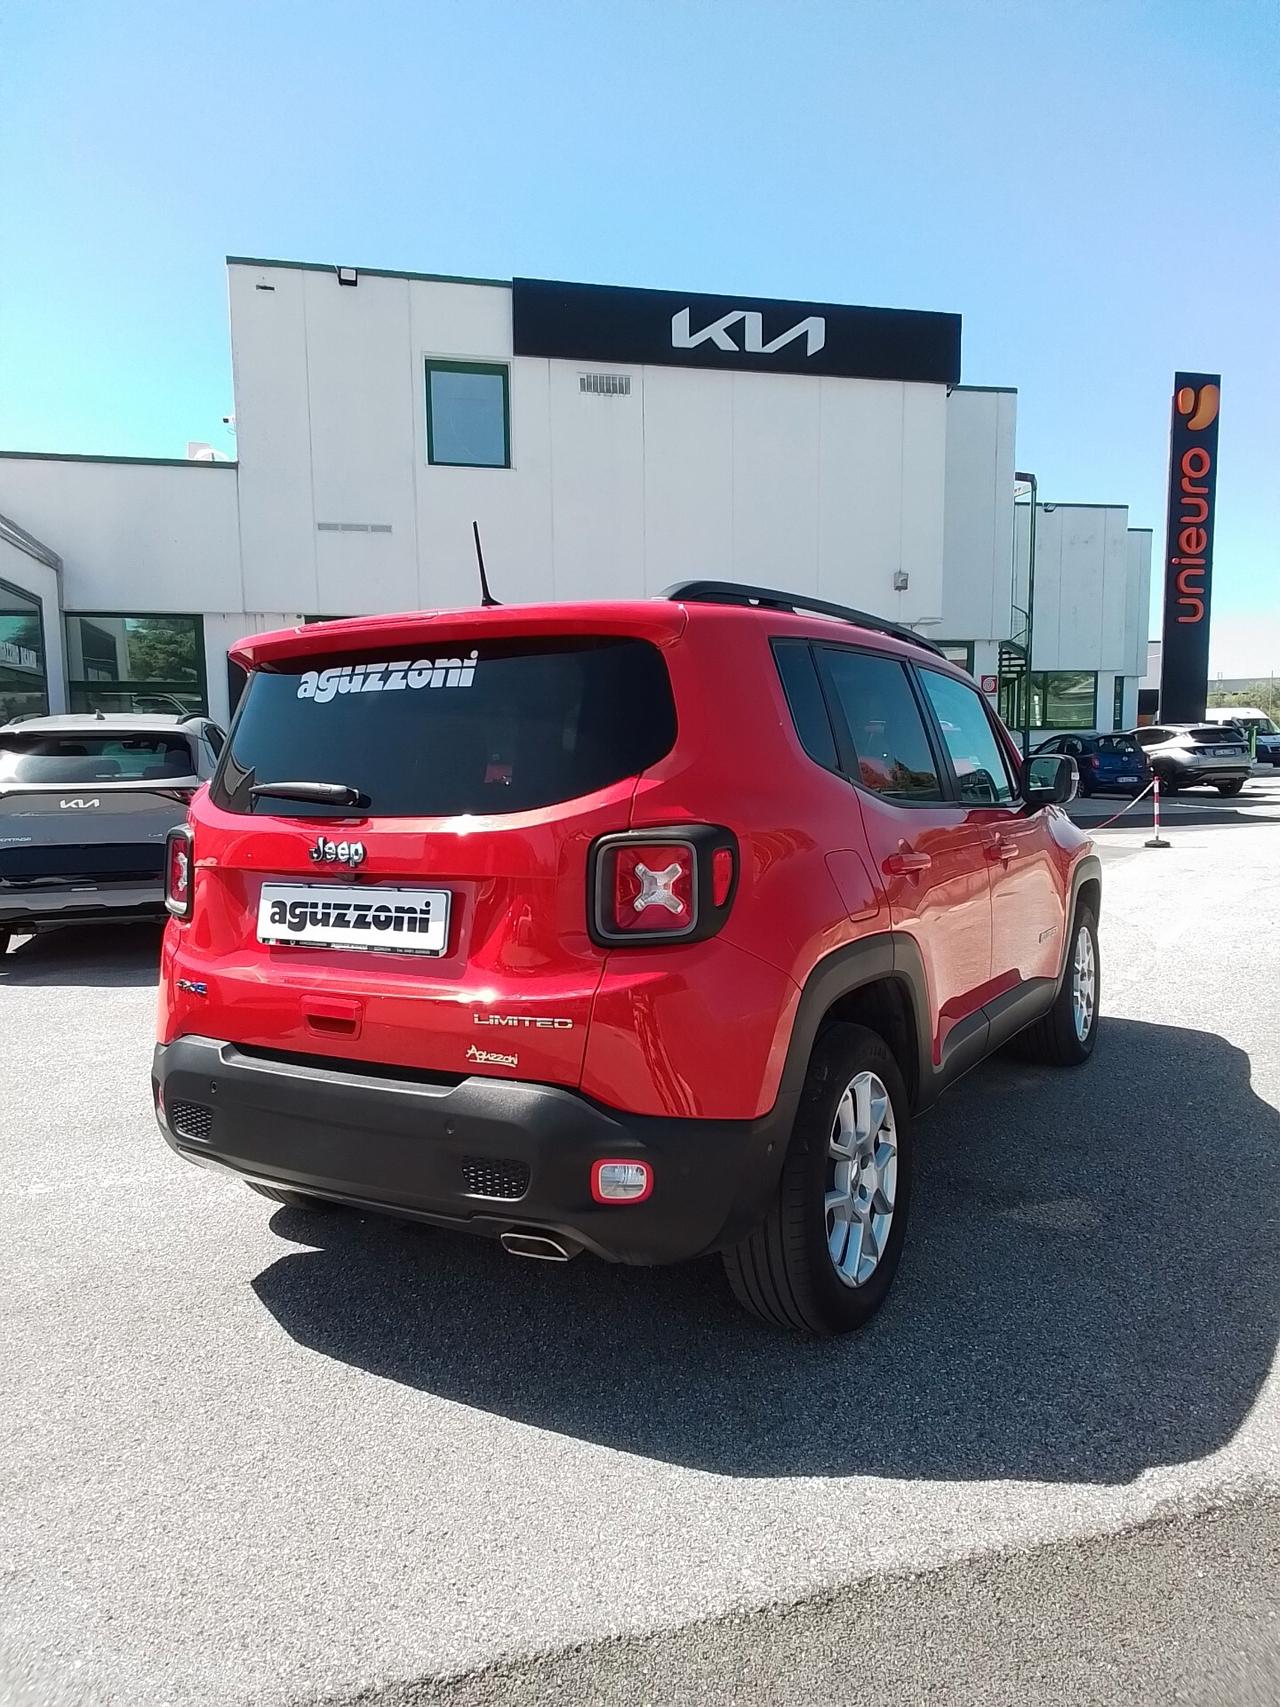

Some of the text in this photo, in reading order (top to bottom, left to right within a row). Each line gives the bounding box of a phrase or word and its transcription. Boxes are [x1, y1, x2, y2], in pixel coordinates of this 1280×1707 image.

[1172, 447, 1210, 623] unieuro
[297, 650, 479, 703] aguzzoni
[309, 836, 365, 867] Jeep
[270, 900, 431, 933] aguzzoni
[473, 1013, 574, 1029] LIMITED
[465, 1044, 518, 1067] Aguzzoni
